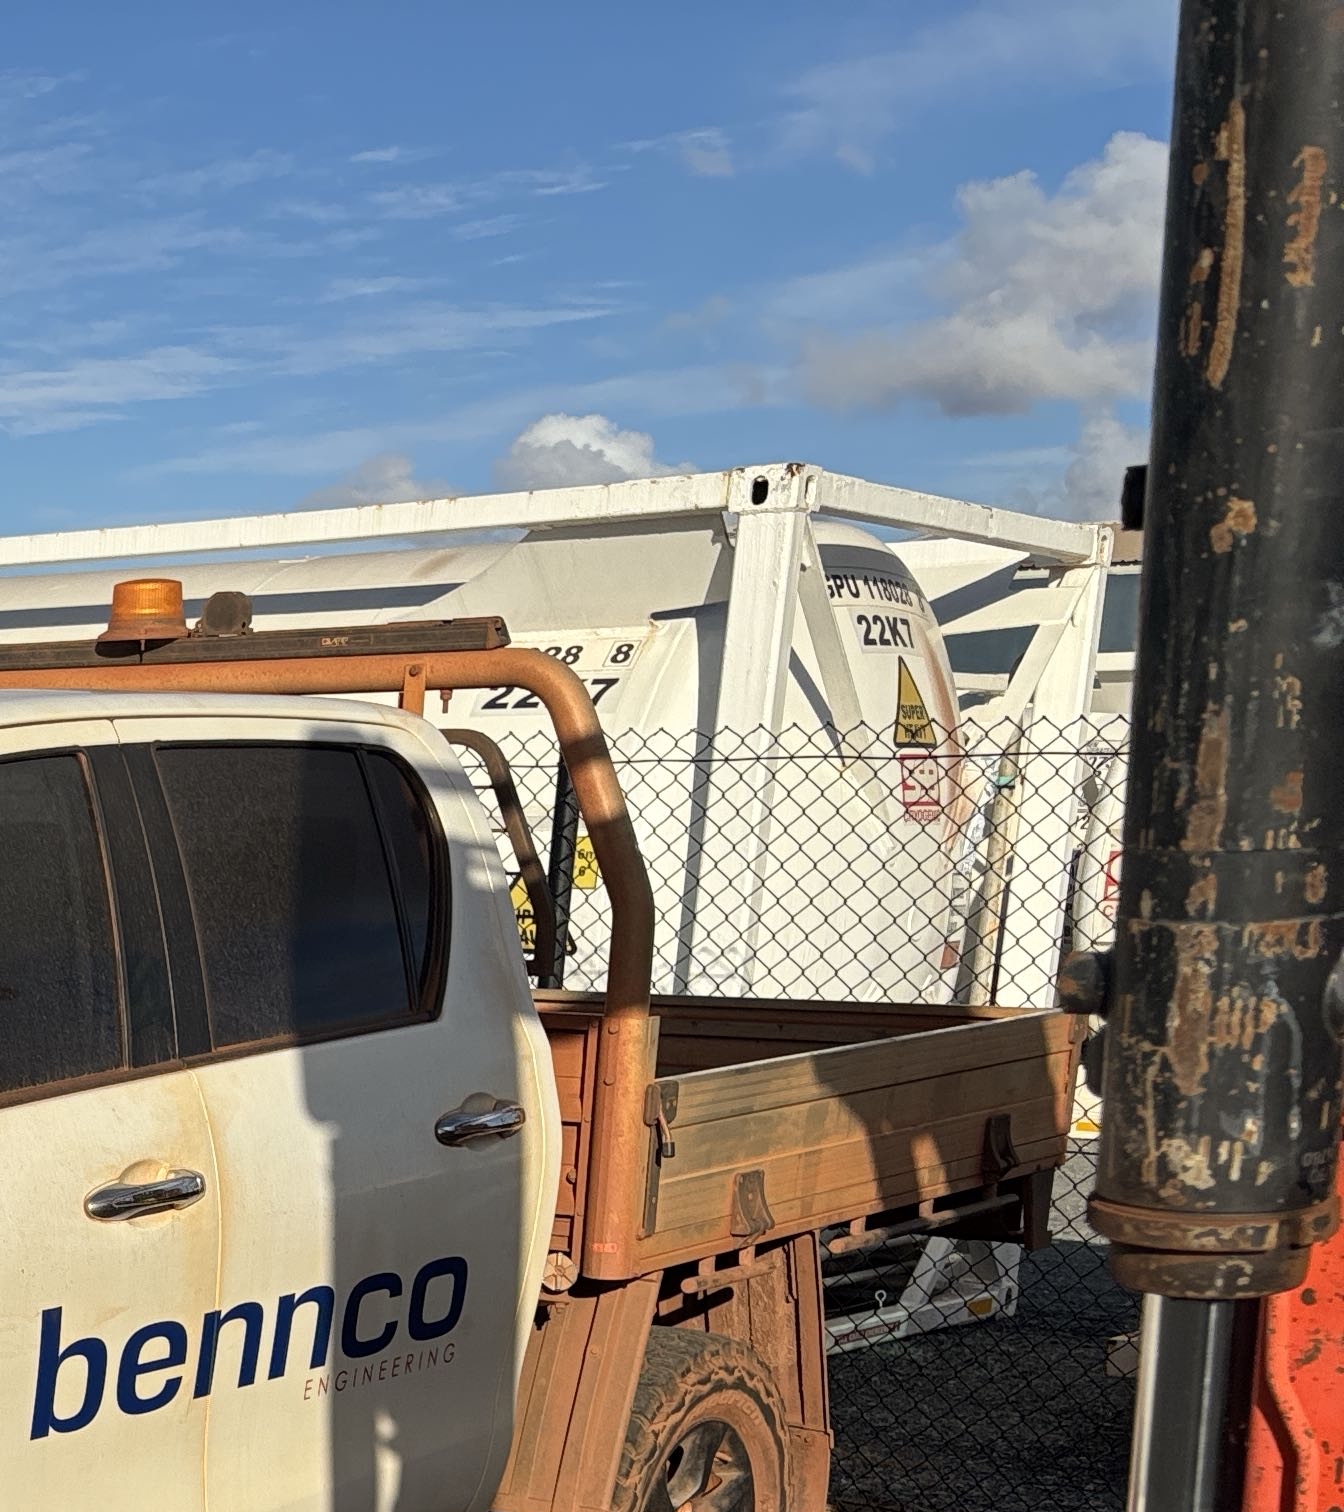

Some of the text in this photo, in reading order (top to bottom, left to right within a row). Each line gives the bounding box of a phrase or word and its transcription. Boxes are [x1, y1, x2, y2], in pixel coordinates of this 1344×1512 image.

[825, 574, 859, 598] GPU
[857, 614, 915, 650] 22K7
[610, 643, 634, 664] 8
[481, 677, 620, 710] 227
[900, 704, 925, 720] SUPER
[30, 1256, 469, 1441] bennco
[303, 1343, 458, 1401] ENGINEERING
